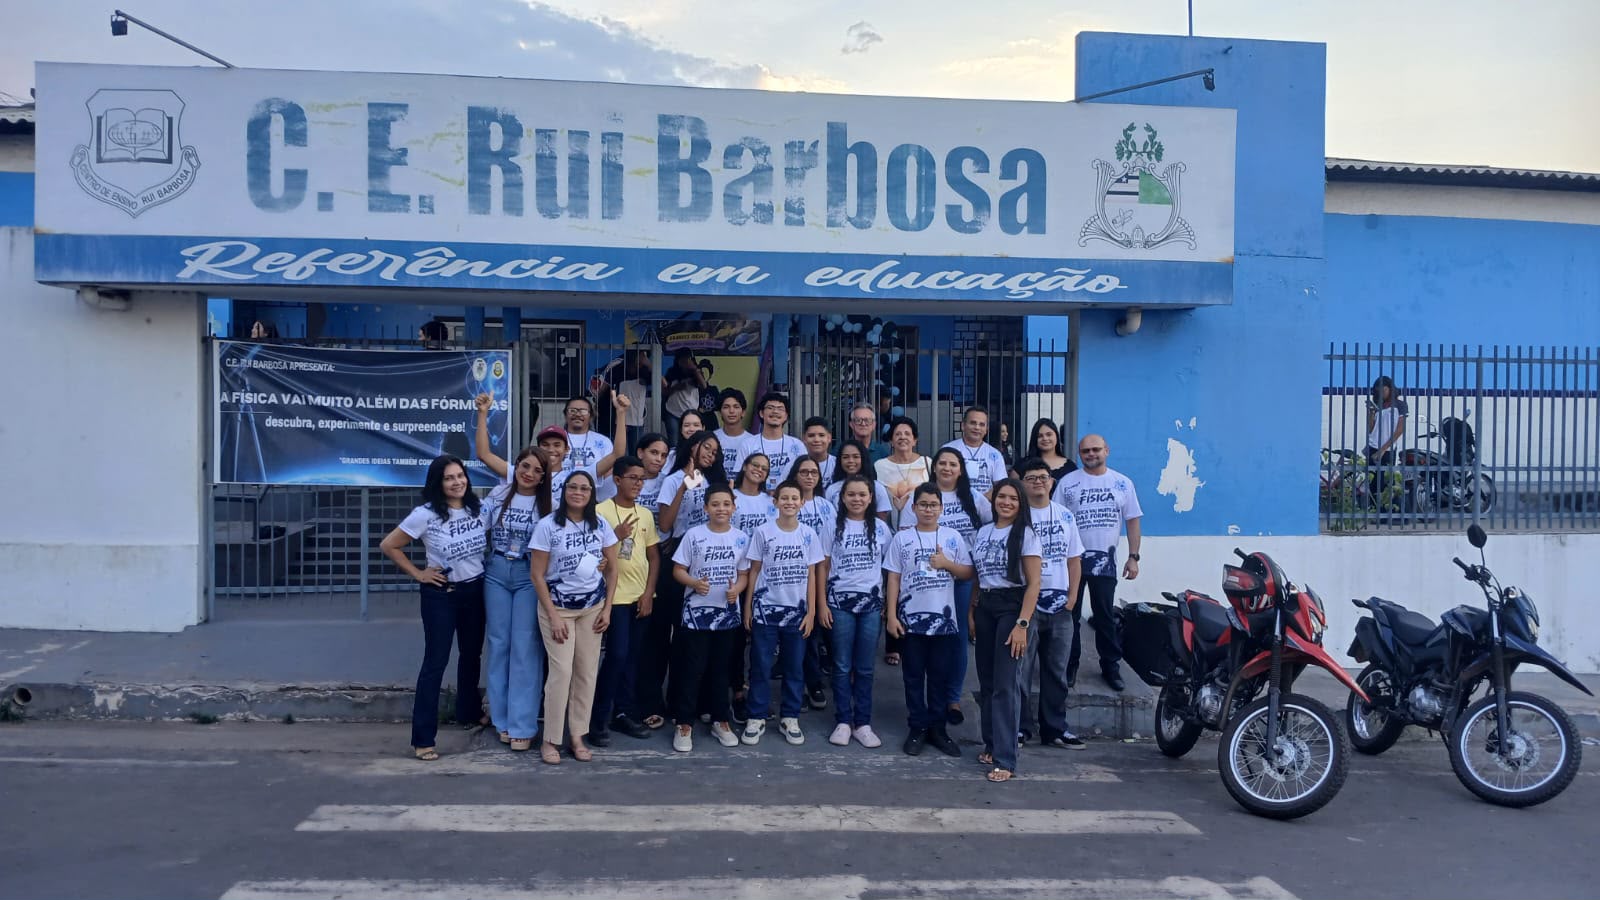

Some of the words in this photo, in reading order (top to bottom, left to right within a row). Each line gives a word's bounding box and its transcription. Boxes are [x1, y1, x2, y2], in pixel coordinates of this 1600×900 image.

[246, 97, 334, 213] C.
[366, 102, 434, 215] E.
[467, 105, 624, 219] Rui
[657, 113, 1047, 235] Barbosa
[79, 163, 102, 191] CENTRO
[101, 186, 112, 198] DE
[111, 193, 138, 210] ENSINO
[141, 193, 155, 205] RUI
[158, 169, 191, 199] BARBOSA
[176, 241, 624, 281] Referência
[657, 260, 771, 285] em
[804, 259, 1128, 298] educação
[252, 360, 288, 370] BARBOSA
[289, 361, 336, 372] APRESENTA:
[220, 391, 230, 403] A
[231, 389, 279, 404] FÍSICA
[281, 393, 306, 406] VAI
[307, 395, 353, 408] MUITO
[355, 394, 397, 409] ALÉM
[399, 398, 429, 410] DAS
[431, 396, 508, 411] FÓRMAS
[265, 416, 315, 429] descubra,
[318, 420, 381, 432] experimente
[383, 422, 390, 431] e
[392, 421, 466, 434] surpreenda-se!
